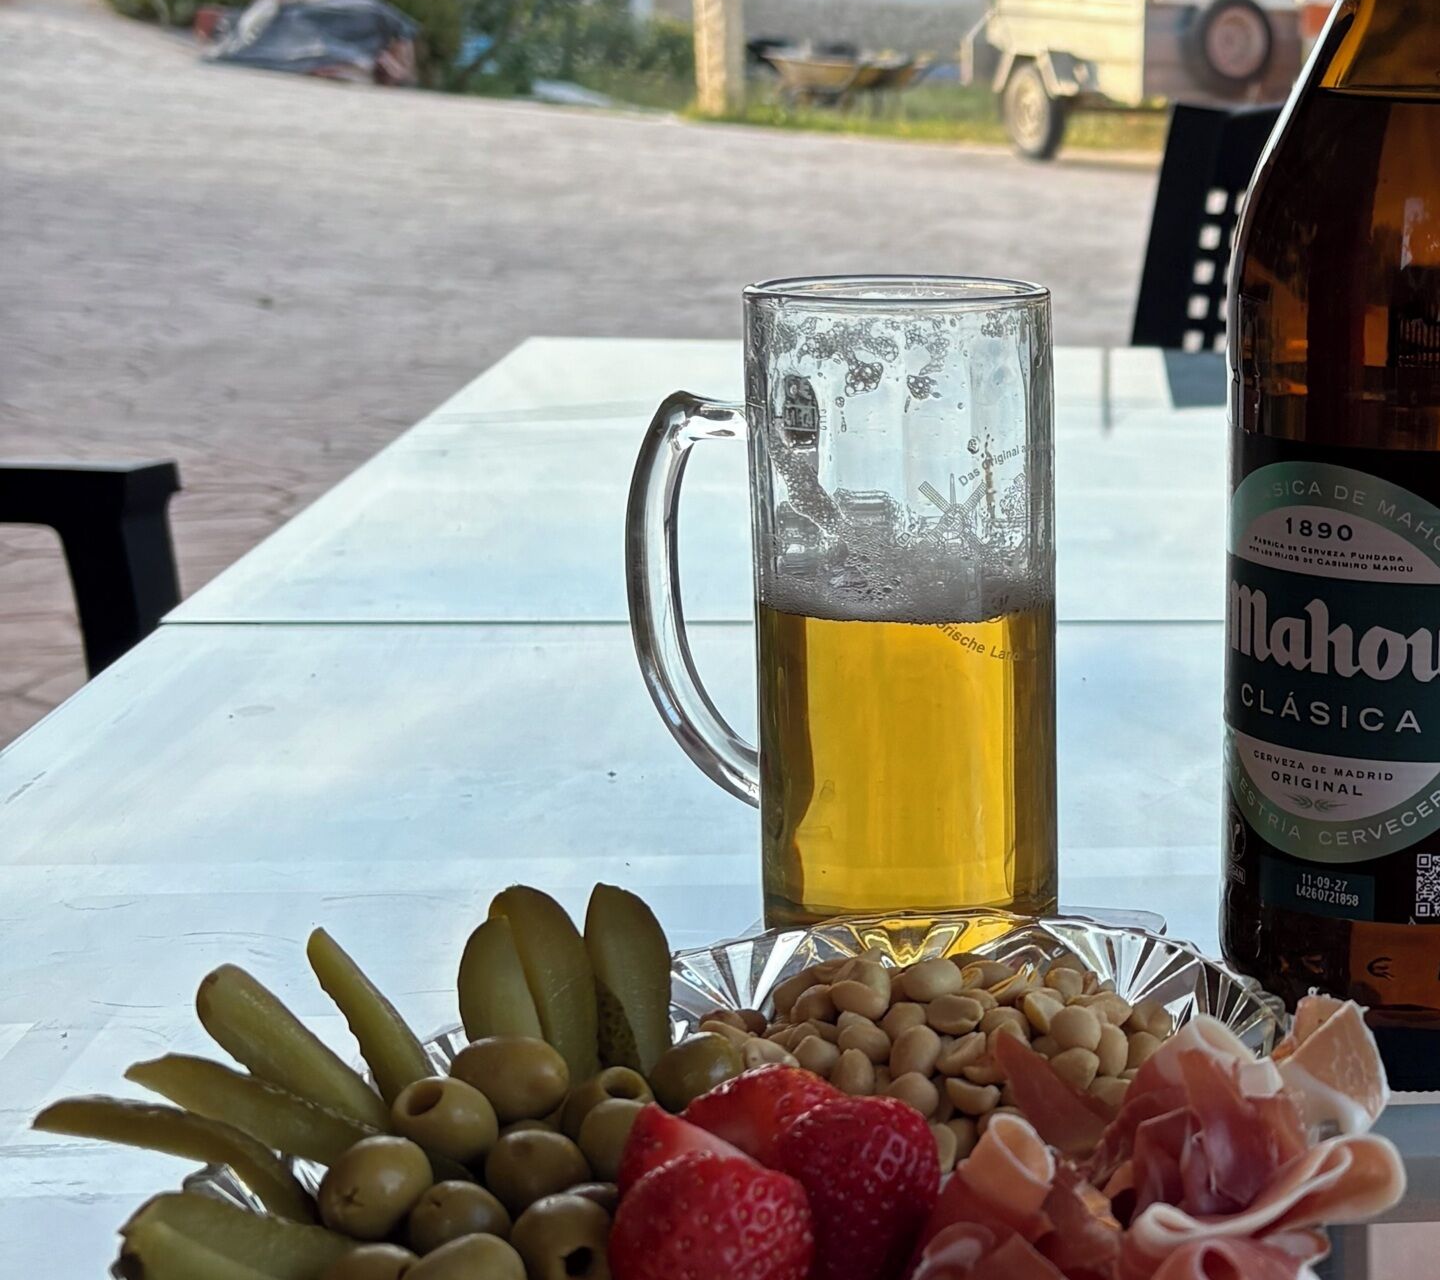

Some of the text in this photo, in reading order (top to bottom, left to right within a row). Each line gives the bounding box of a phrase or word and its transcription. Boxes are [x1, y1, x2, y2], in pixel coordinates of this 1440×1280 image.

[958, 467, 981, 487] Das
[1267, 479, 1323, 498] SICA
[1334, 485, 1366, 506] DE
[1285, 517, 1353, 542] 1890
[1240, 682, 1422, 735] CLÁSICA
[1253, 750, 1393, 781] CERVEZA DE MADRID
[1271, 771, 1363, 797] ORIGINAL
[1296, 883, 1359, 907] L4260721858
[1302, 873, 1348, 892] 11-09-27
